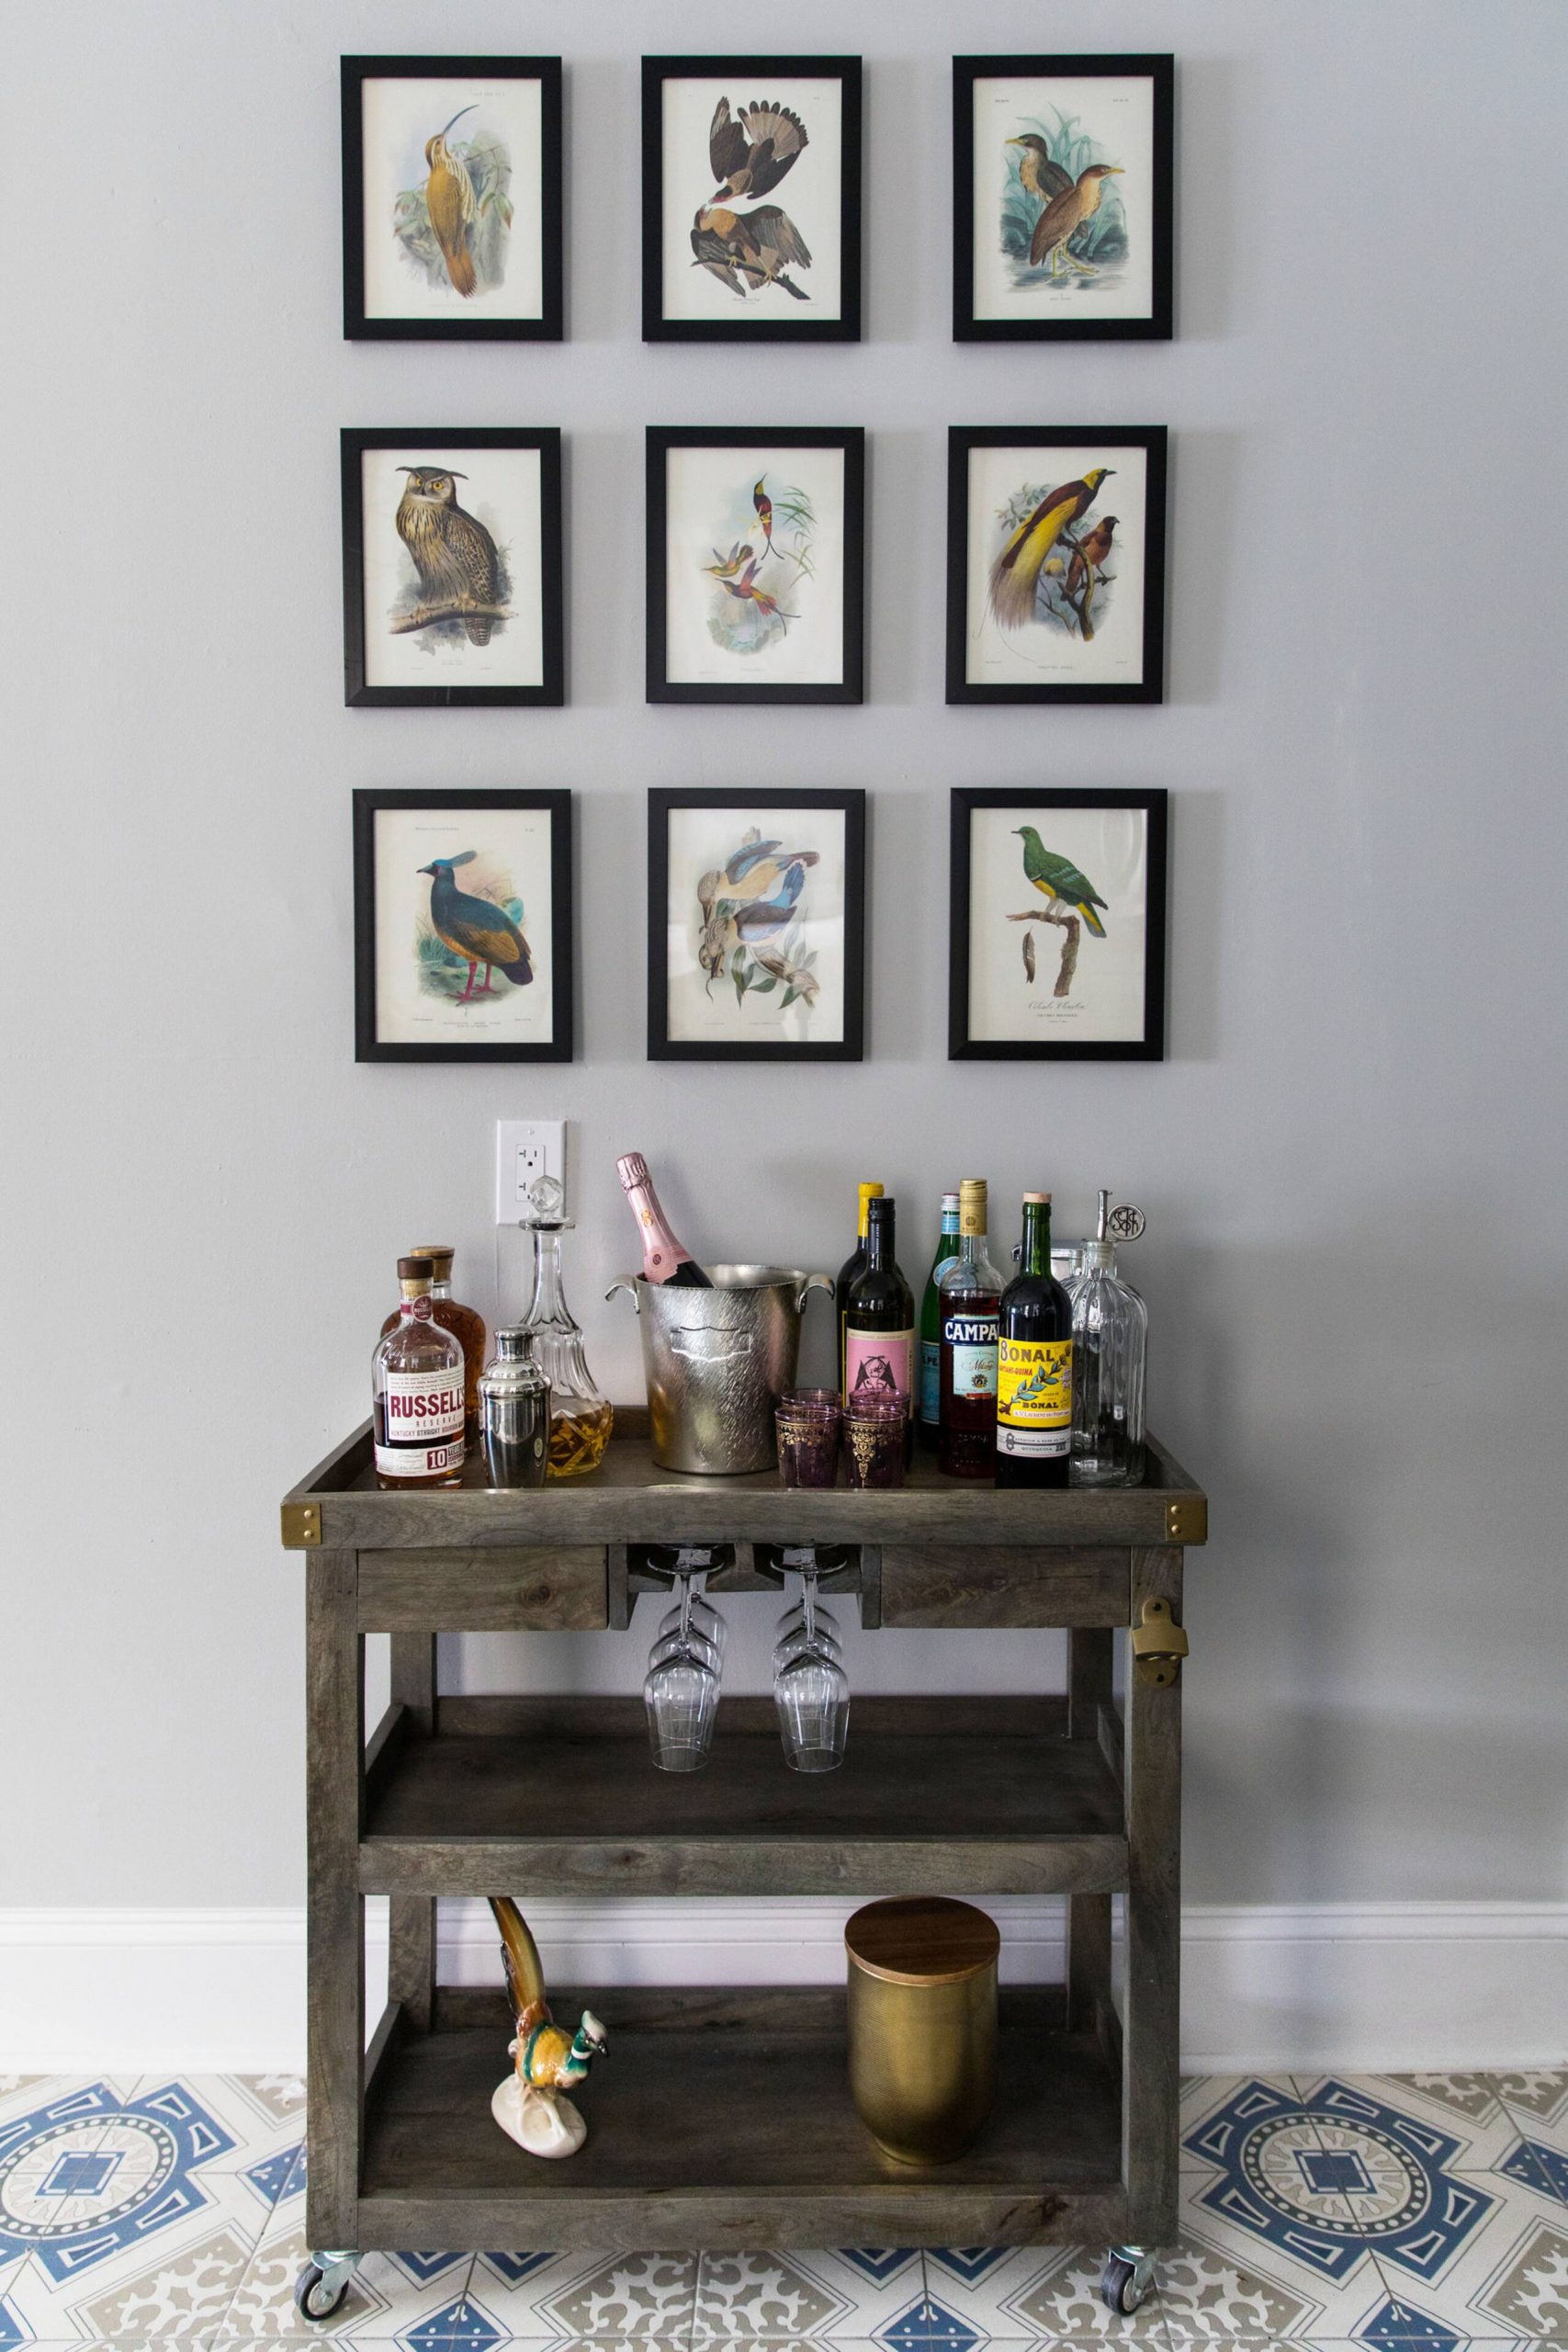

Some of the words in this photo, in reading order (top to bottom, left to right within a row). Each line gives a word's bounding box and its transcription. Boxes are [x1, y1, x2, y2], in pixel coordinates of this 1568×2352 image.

[944, 1321, 998, 1341] CAMPA
[1000, 1340, 1055, 1363] BONAL
[416, 1417, 457, 1427] RESERVE
[416, 1428, 440, 1436] STRAIGHT
[429, 1450, 446, 1469] 10
